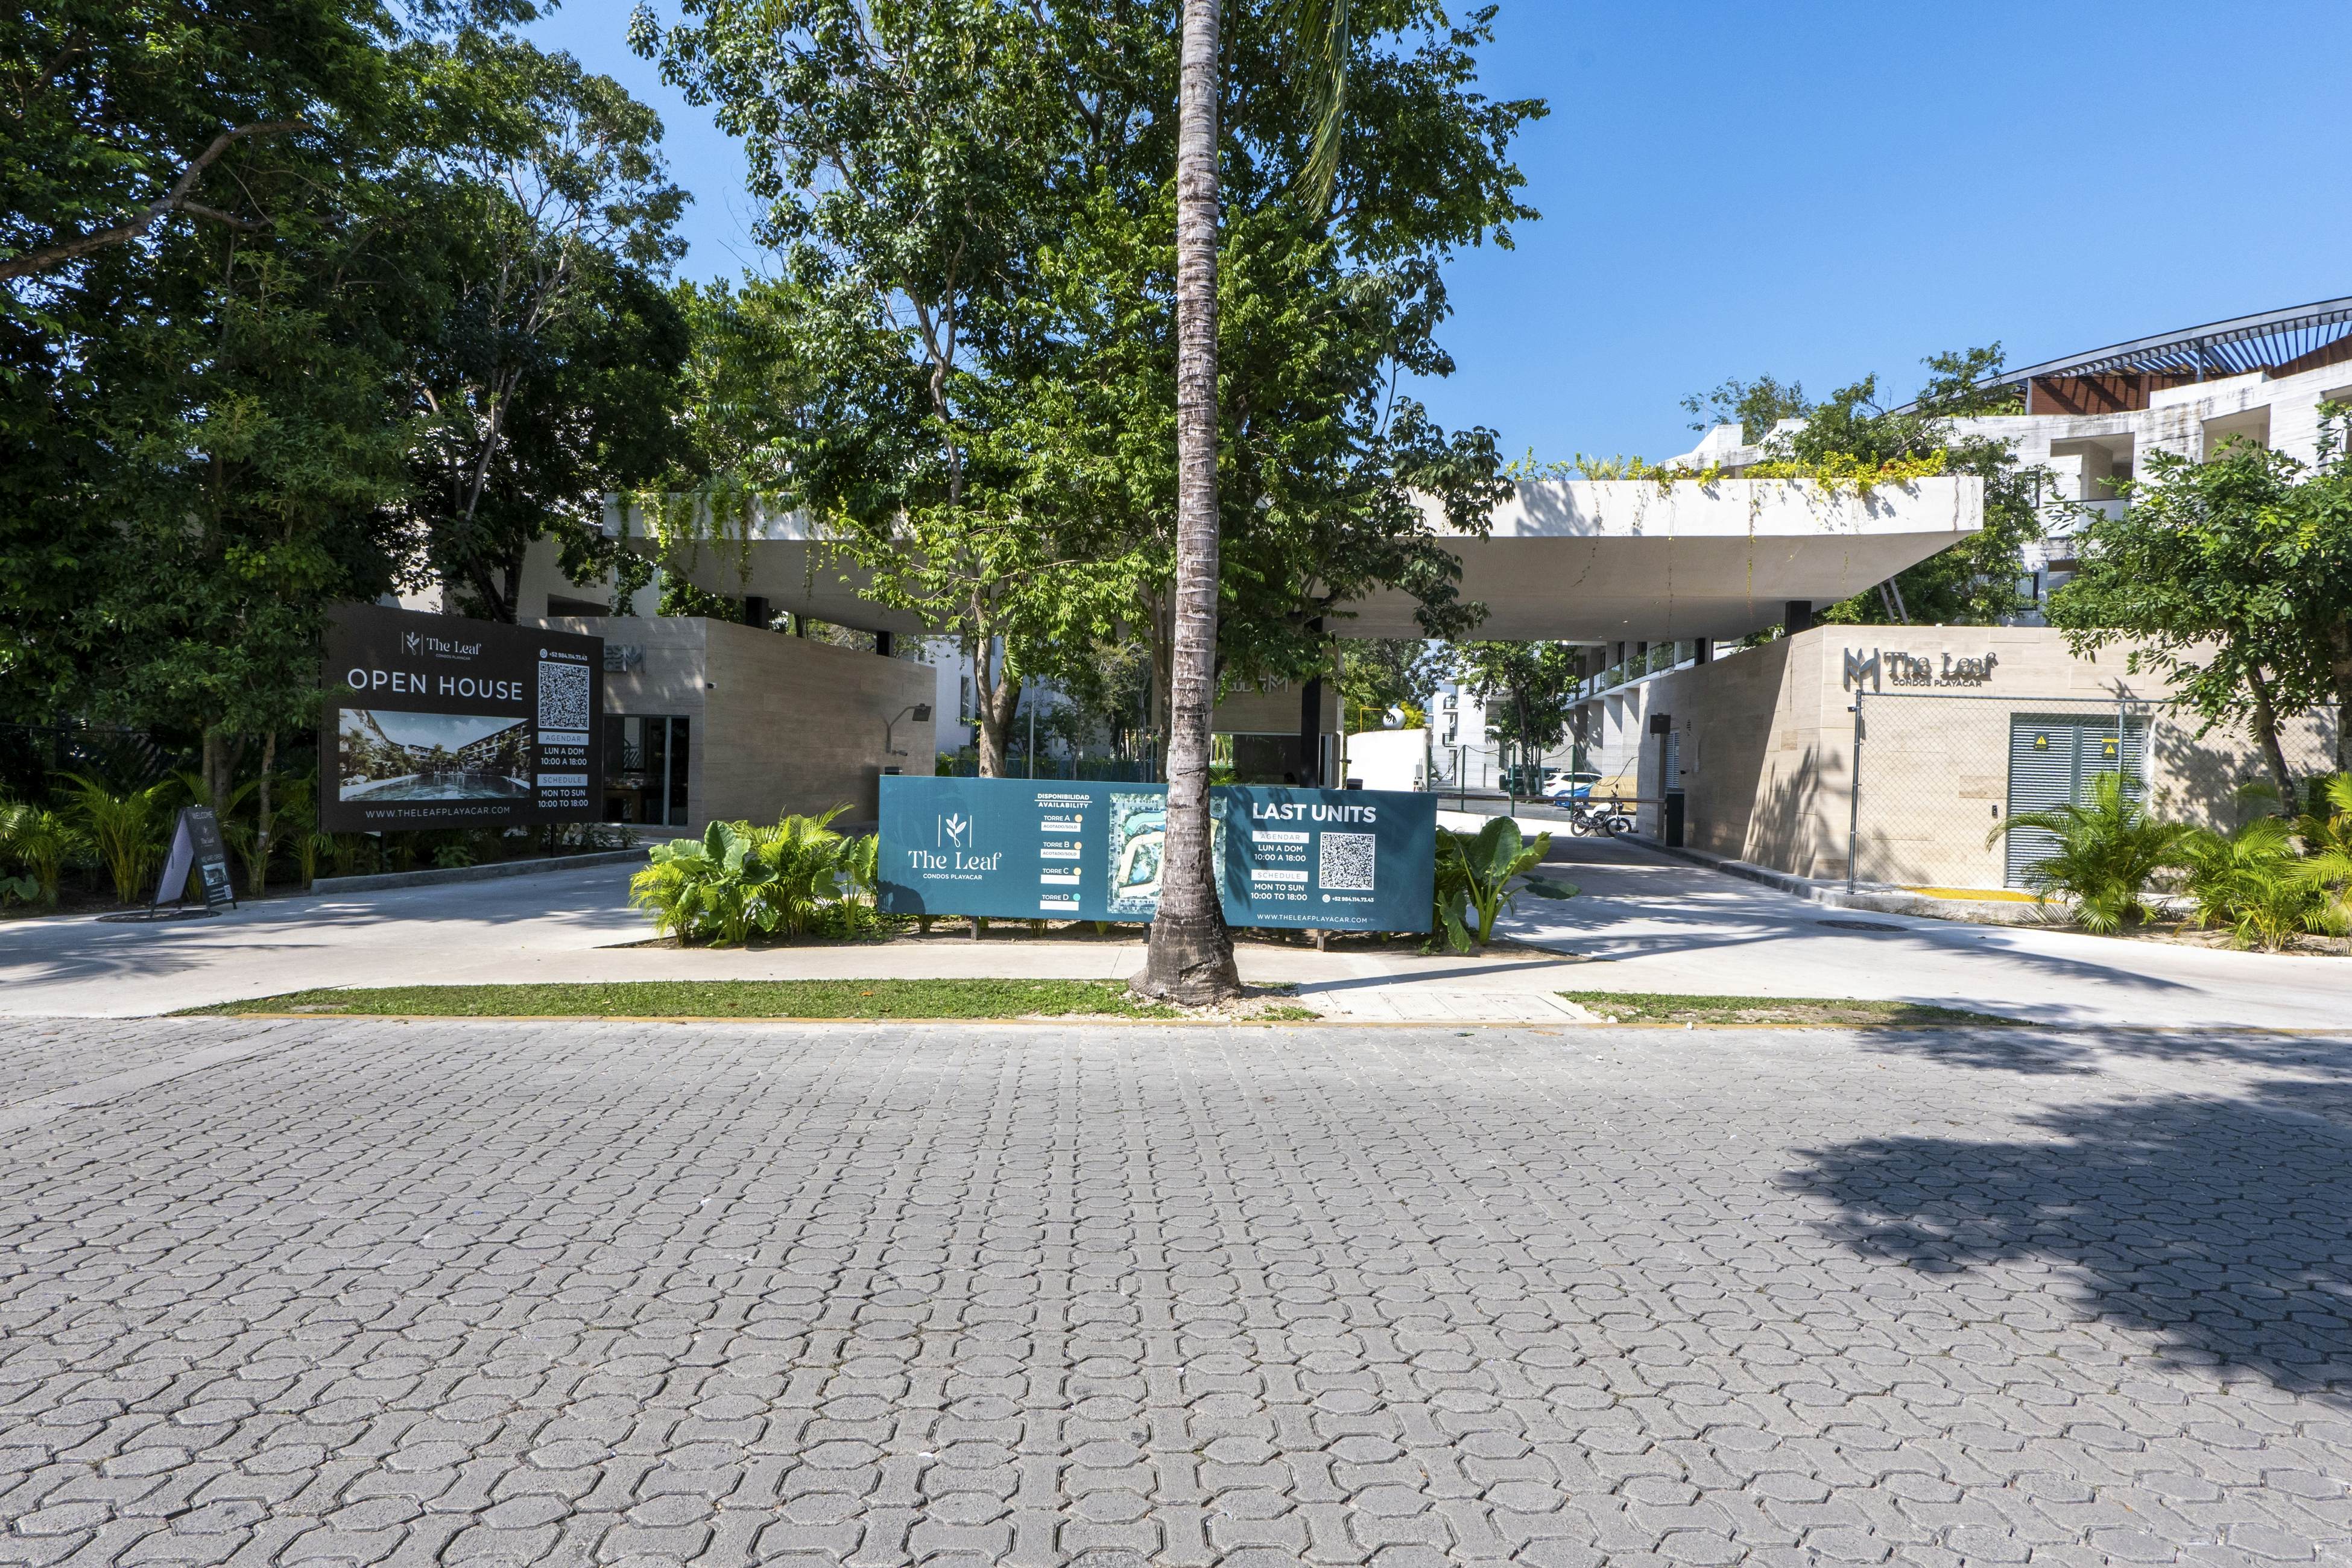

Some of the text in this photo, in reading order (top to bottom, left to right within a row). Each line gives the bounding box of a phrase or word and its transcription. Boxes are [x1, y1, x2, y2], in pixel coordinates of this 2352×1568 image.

[426, 637, 482, 655] The Leaf
[1883, 652, 1999, 676] The Leaf
[347, 668, 523, 701] OPEN HOUSE
[1934, 679, 1982, 688] PLAYACAR
[365, 806, 511, 818] WWW.THELEAFPLAYACAR.COM
[1252, 803, 1377, 823] LAST UNITS
[908, 850, 1002, 870] The Leaf
[1257, 914, 1367, 923] WWW.THELEAFPLAYACAR.COM
